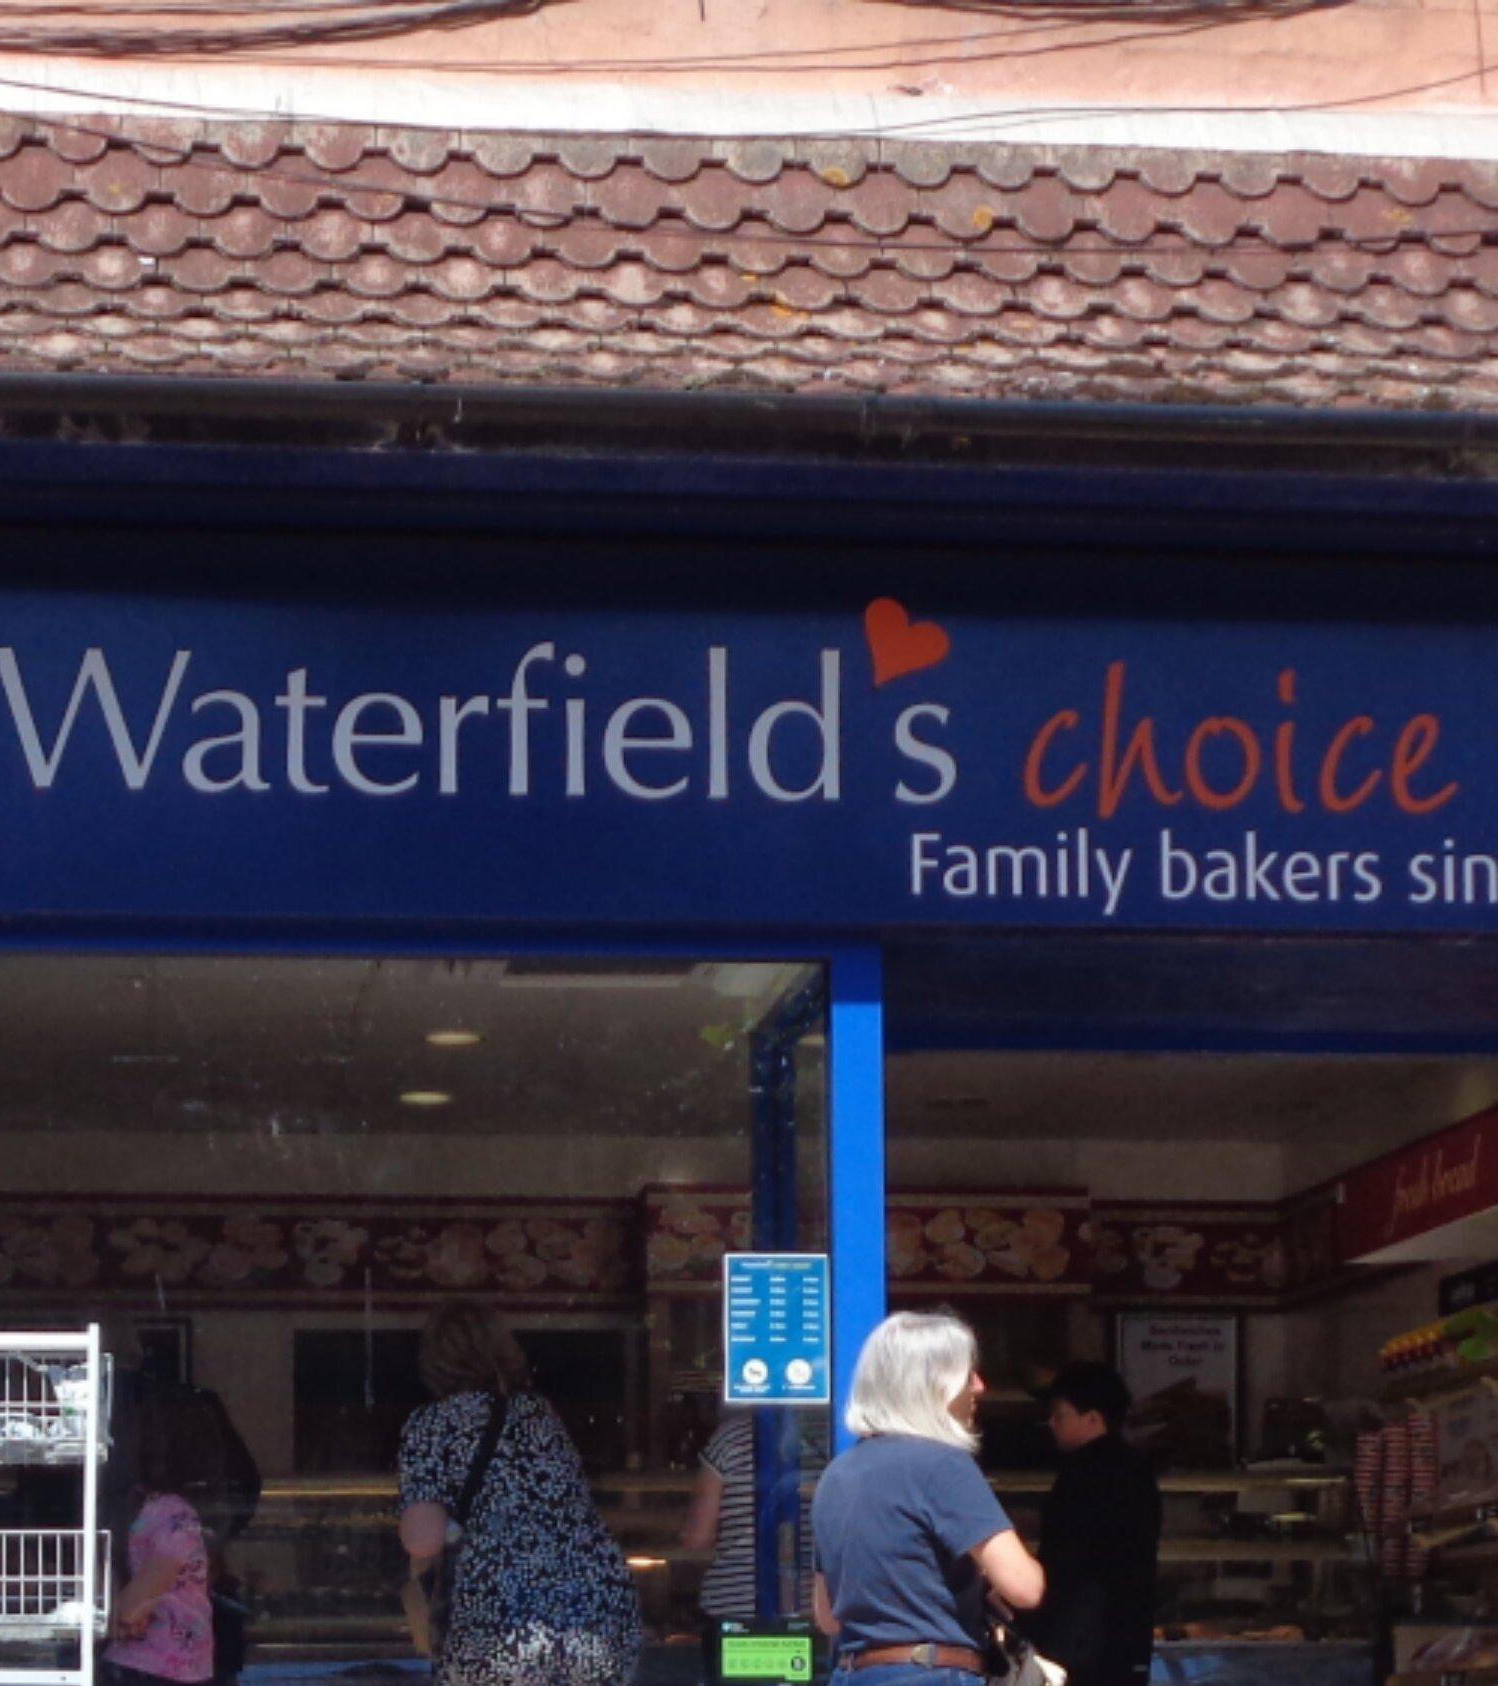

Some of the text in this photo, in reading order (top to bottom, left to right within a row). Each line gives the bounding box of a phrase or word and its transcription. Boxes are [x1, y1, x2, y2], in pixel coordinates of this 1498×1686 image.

[1022, 660, 1459, 818] choice
[910, 828, 1132, 916] Family
[1160, 829, 1383, 904] bakers
